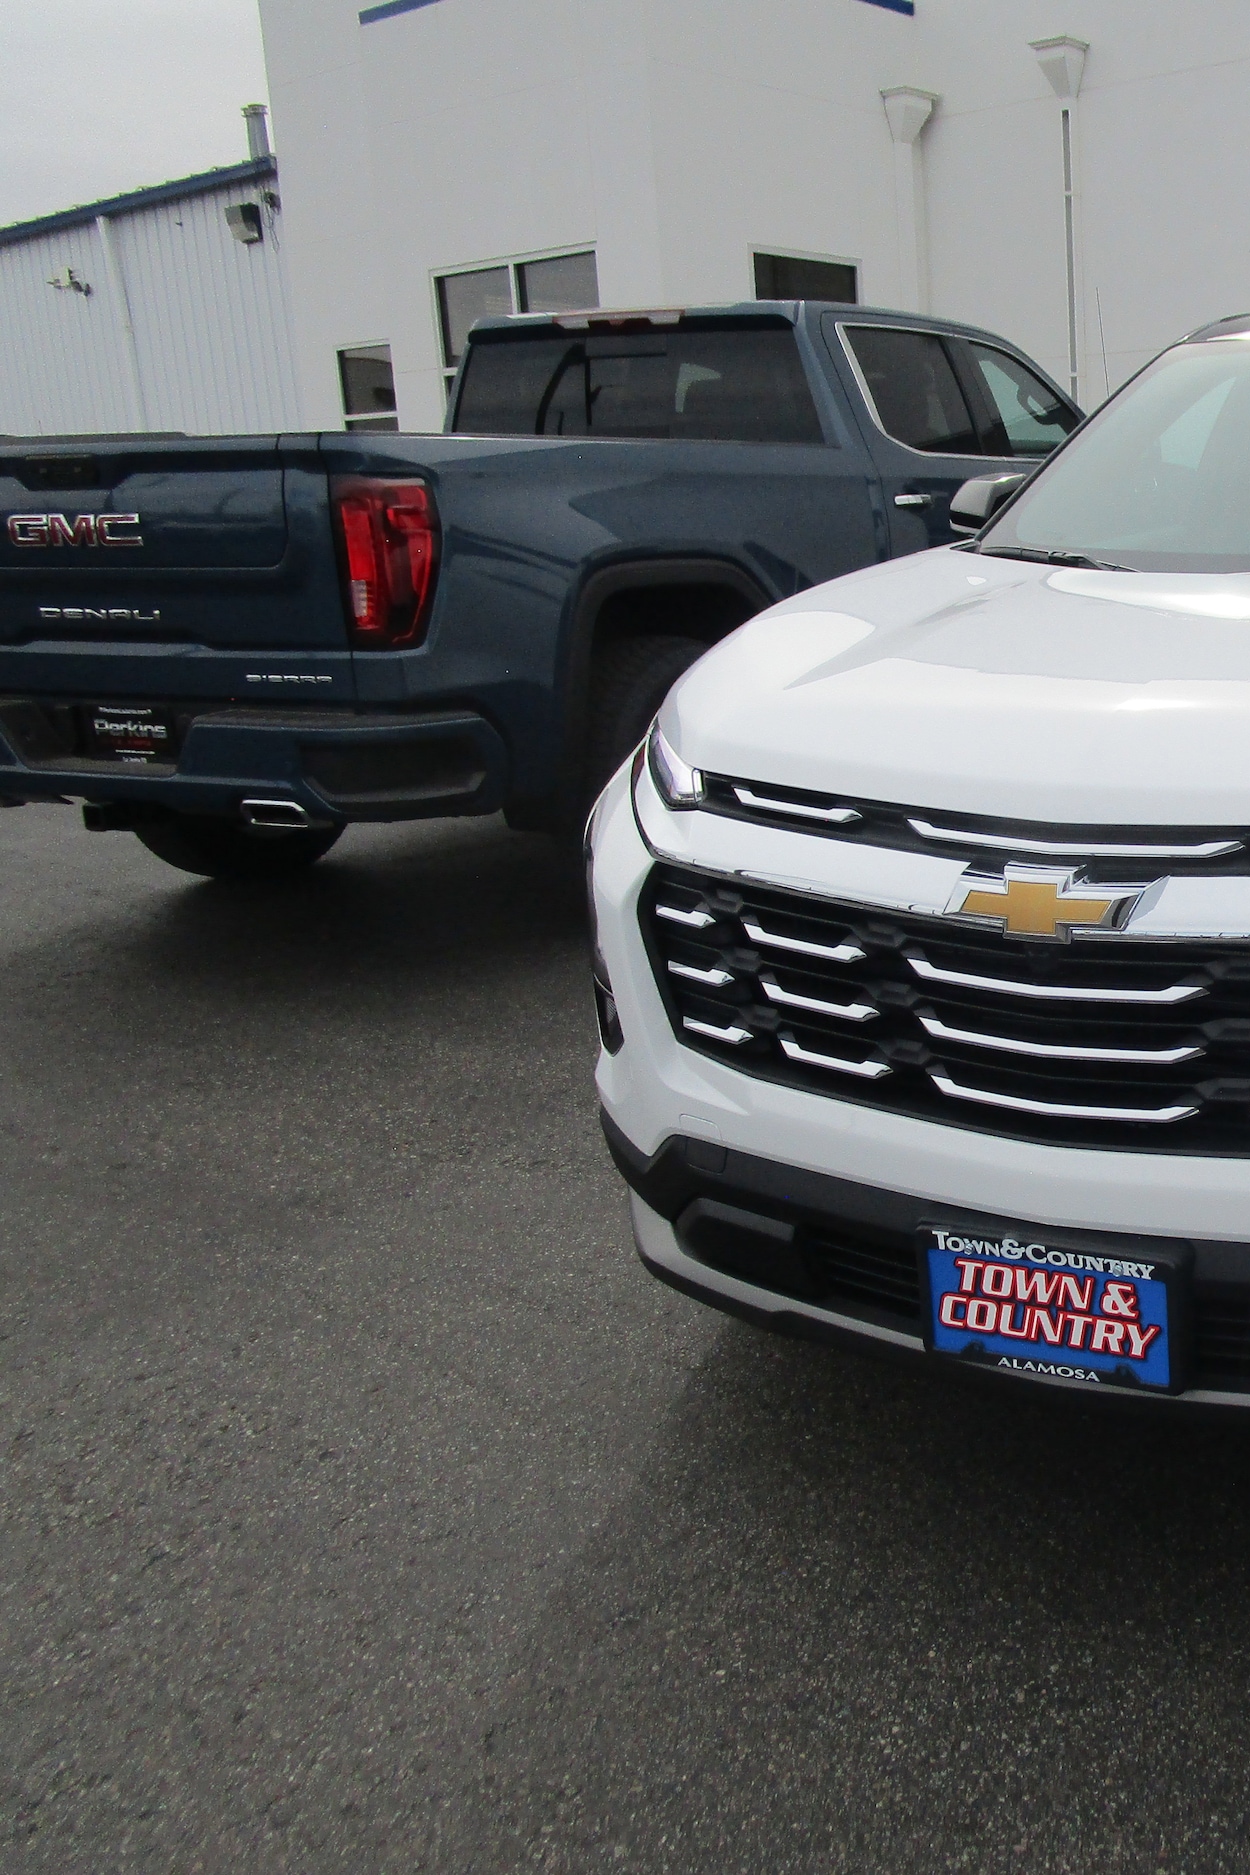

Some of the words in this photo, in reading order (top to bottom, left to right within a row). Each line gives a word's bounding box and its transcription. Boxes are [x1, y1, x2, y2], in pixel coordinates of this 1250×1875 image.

[7, 513, 144, 547] GMC
[39, 606, 161, 621] DENALI
[245, 674, 333, 684] SIERRA
[94, 718, 168, 739] Perkins
[955, 1259, 1094, 1312] TOWN
[1101, 1280, 1140, 1319] &
[938, 1293, 1160, 1359] COUNTRY
[997, 1356, 1101, 1383] ALAMOSA
